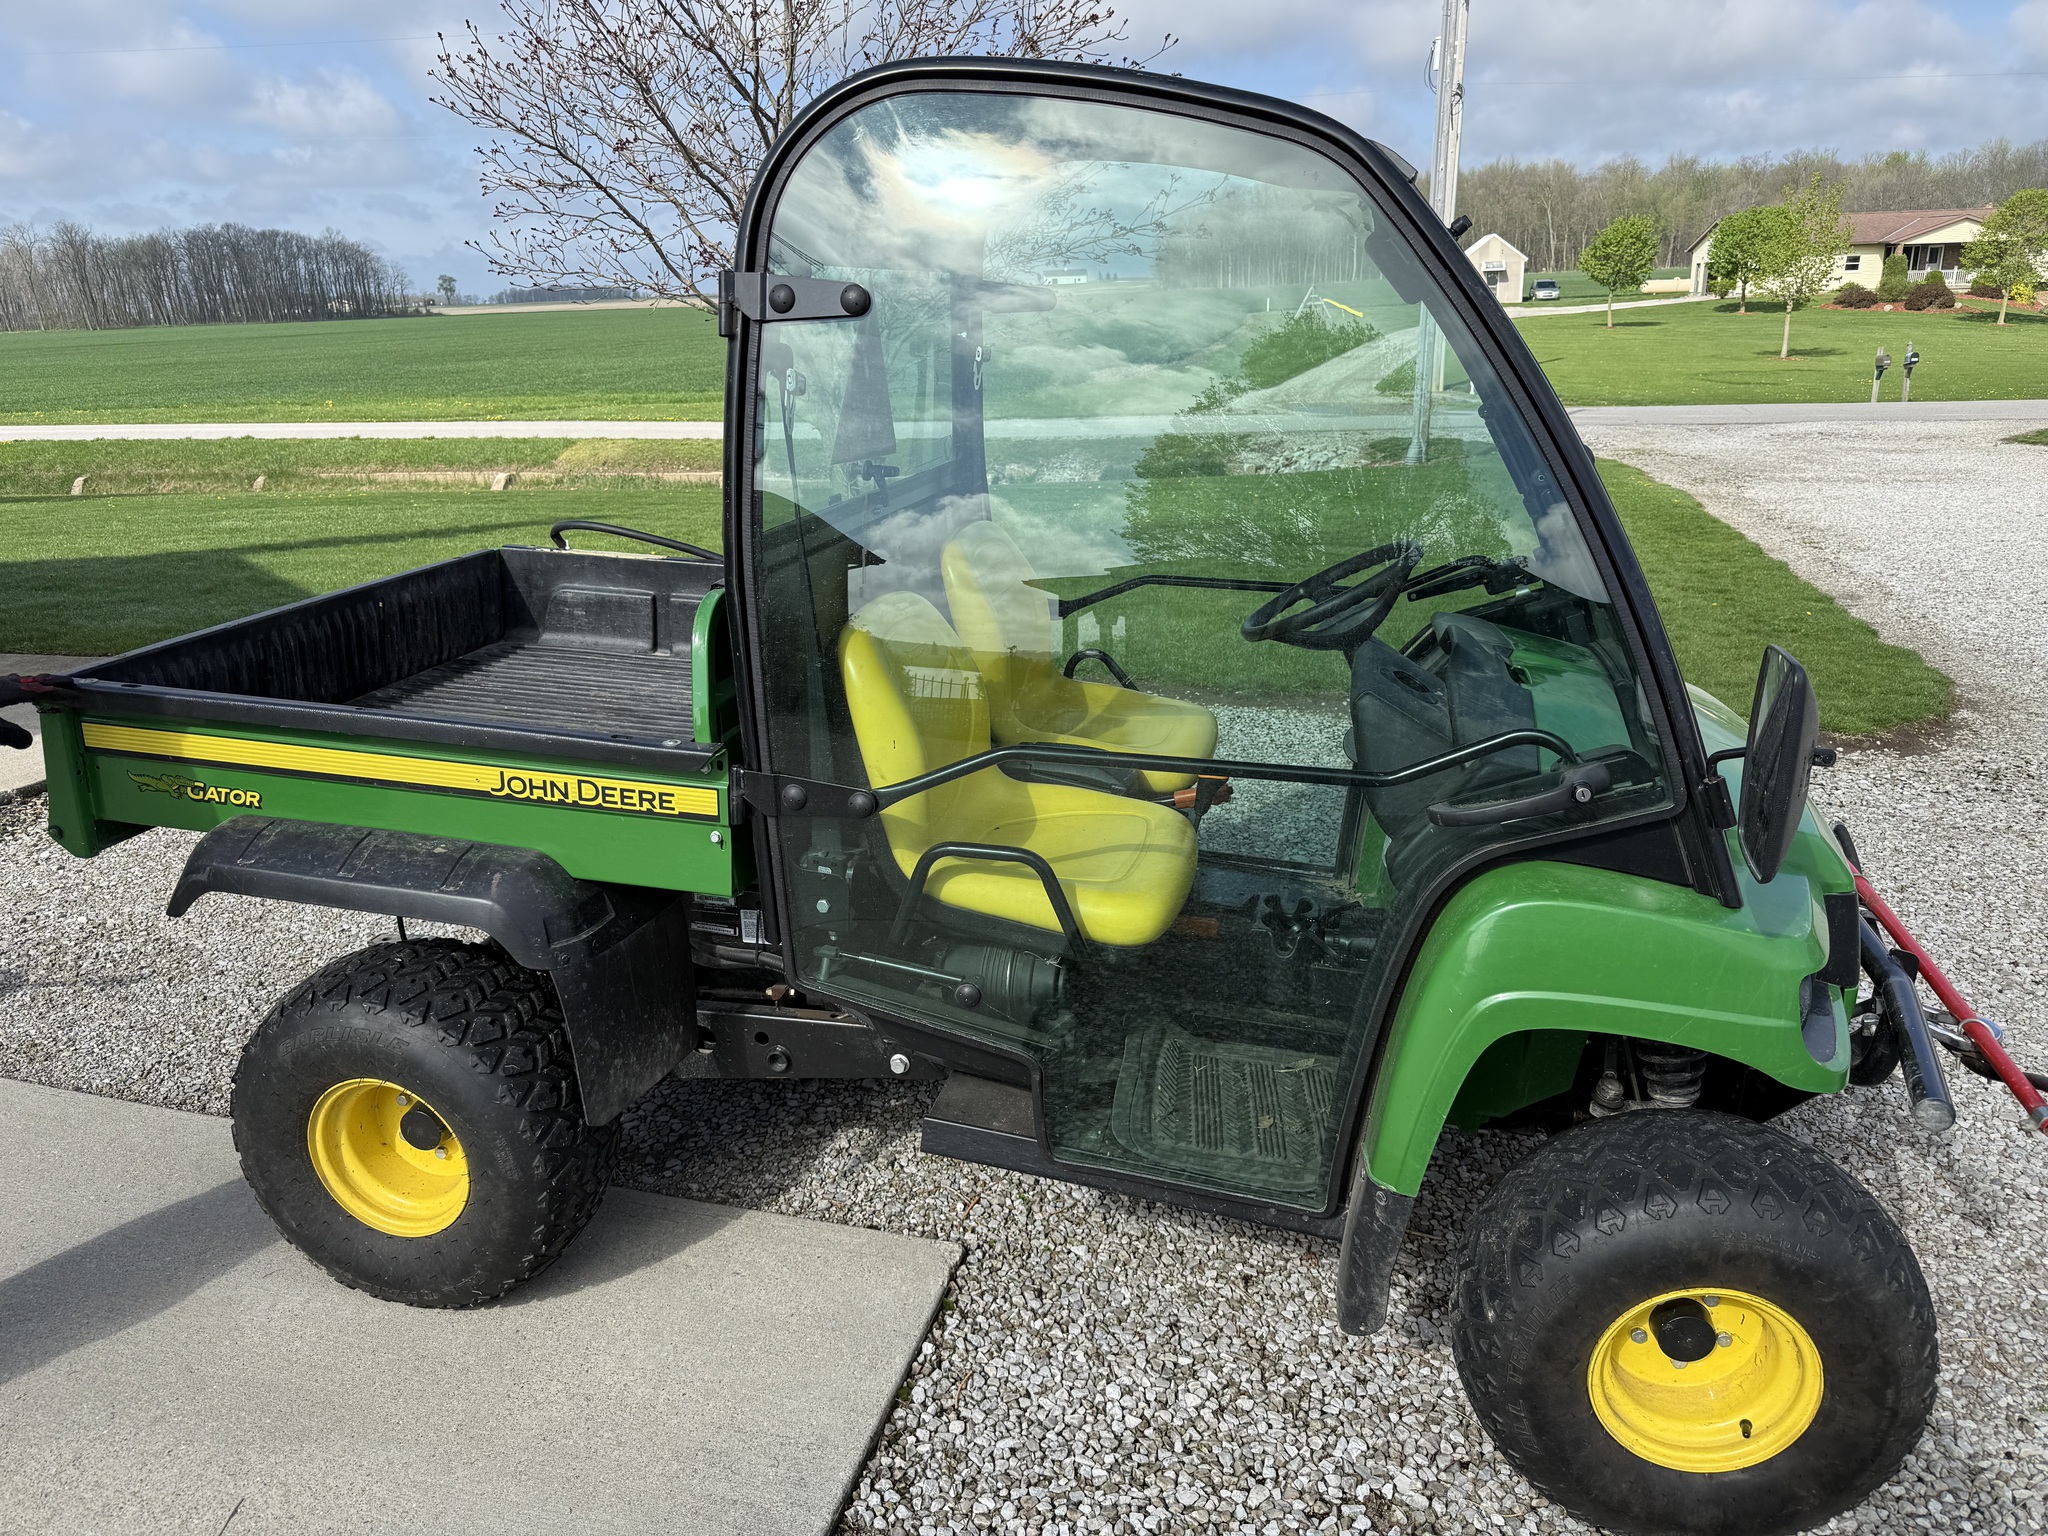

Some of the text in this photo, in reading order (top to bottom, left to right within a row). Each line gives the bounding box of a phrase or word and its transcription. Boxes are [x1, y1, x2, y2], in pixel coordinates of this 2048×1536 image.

[186, 781, 261, 808] GATOR
[490, 770, 677, 812] JOHN DEERE
[279, 1026, 410, 1058] CARLISLE
[1506, 1305, 1553, 1385] TRAIL
[1507, 1399, 1543, 1455] ALL
